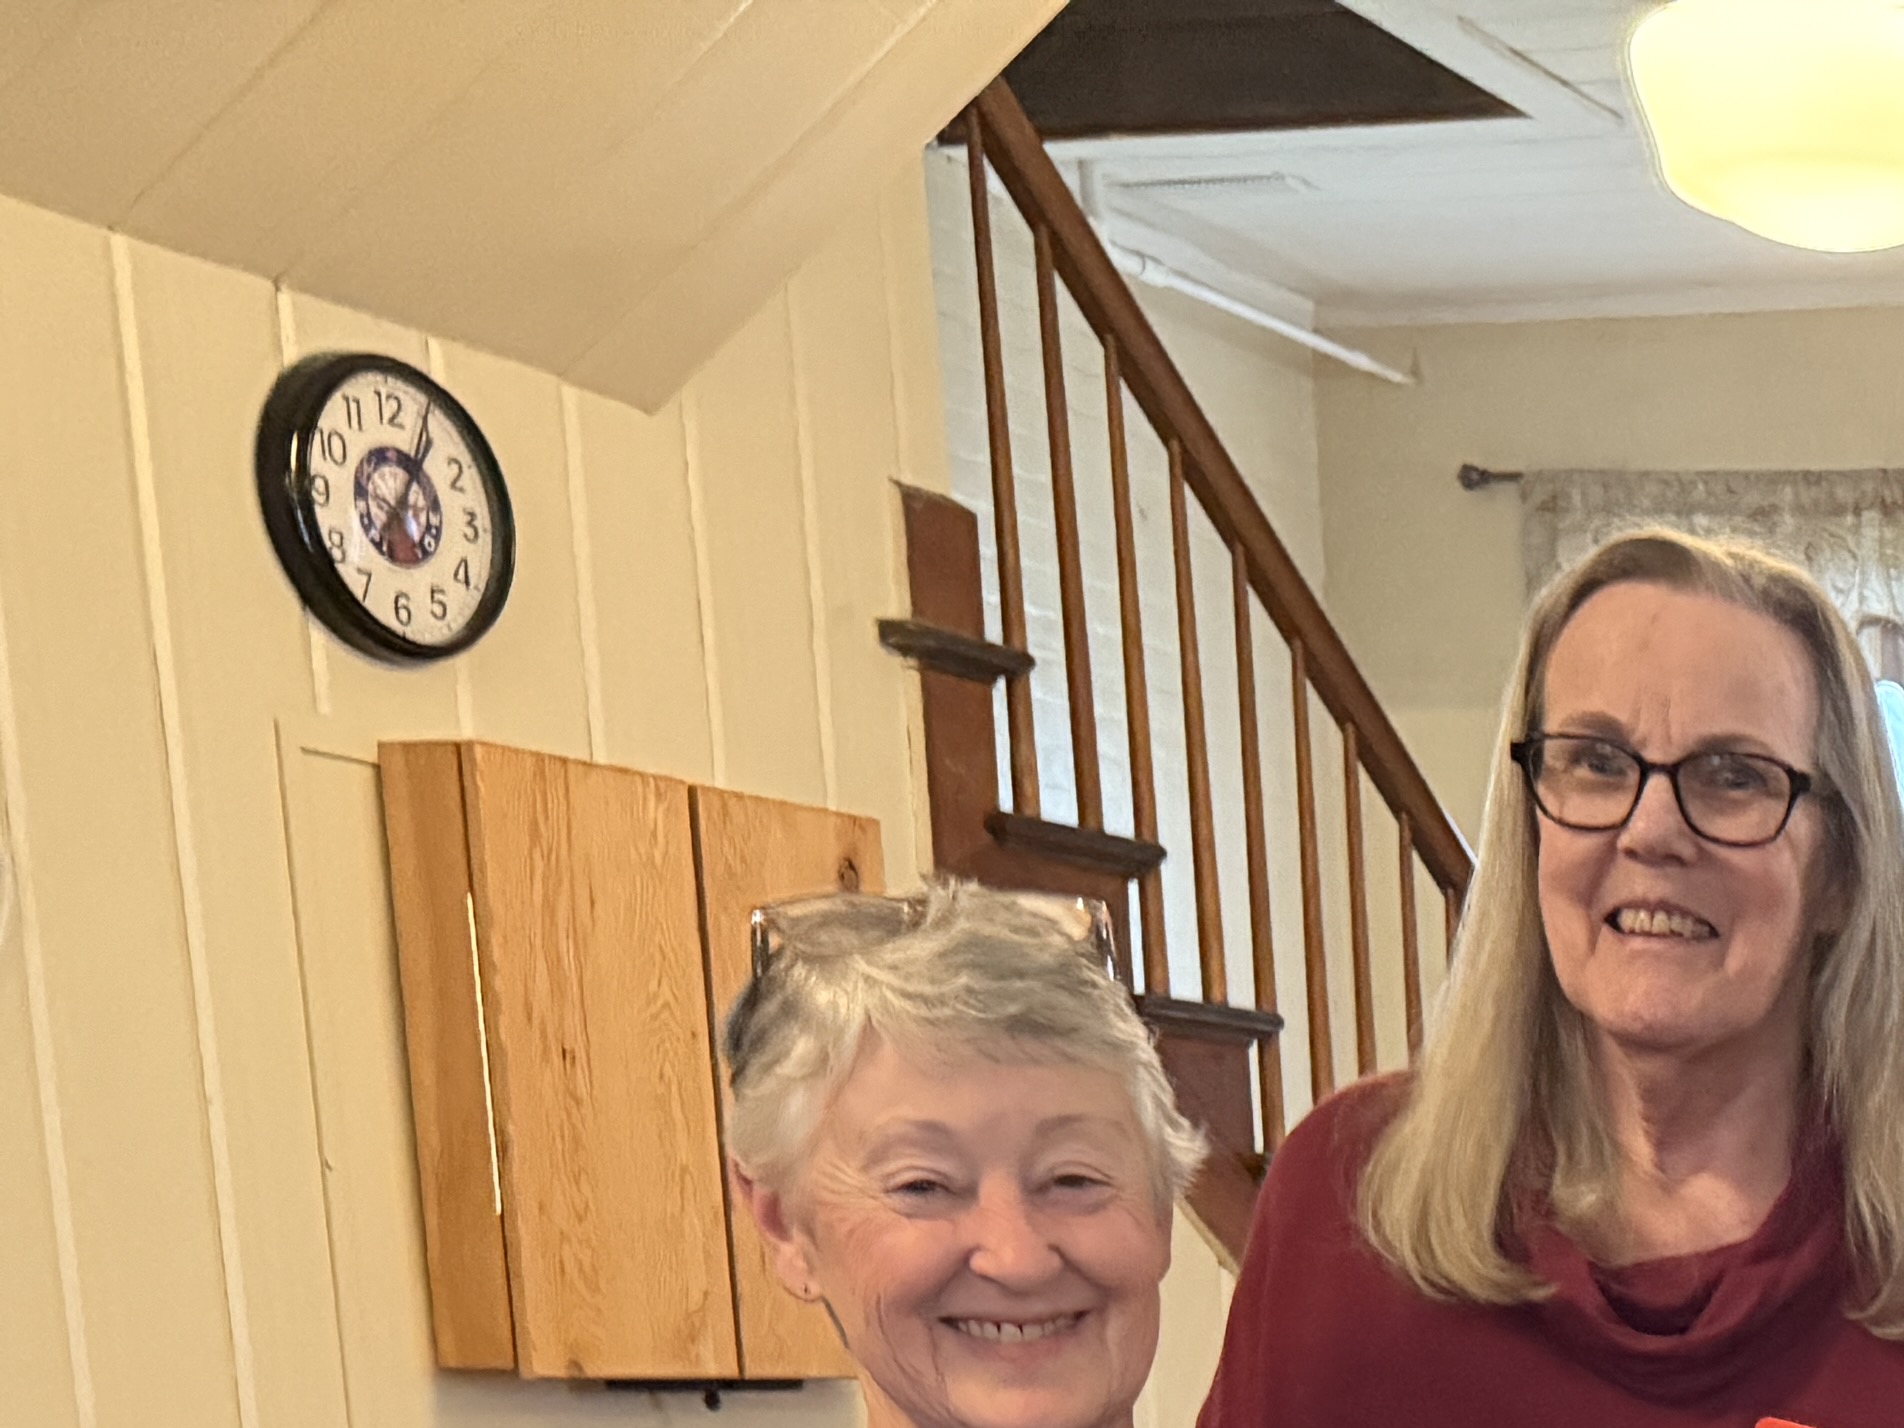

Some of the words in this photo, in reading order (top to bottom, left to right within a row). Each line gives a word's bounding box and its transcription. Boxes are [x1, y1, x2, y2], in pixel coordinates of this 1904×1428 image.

[343, 393, 363, 431] 11
[374, 390, 404, 429] 12
[317, 428, 346, 466] 10
[311, 474, 329, 506] 9
[447, 458, 465, 493] 2
[462, 508, 478, 543] 3
[328, 527, 345, 563] 8
[357, 568, 372, 602] 7
[454, 557, 471, 590] 4
[395, 592, 411, 626] 6
[430, 586, 447, 620] 5
